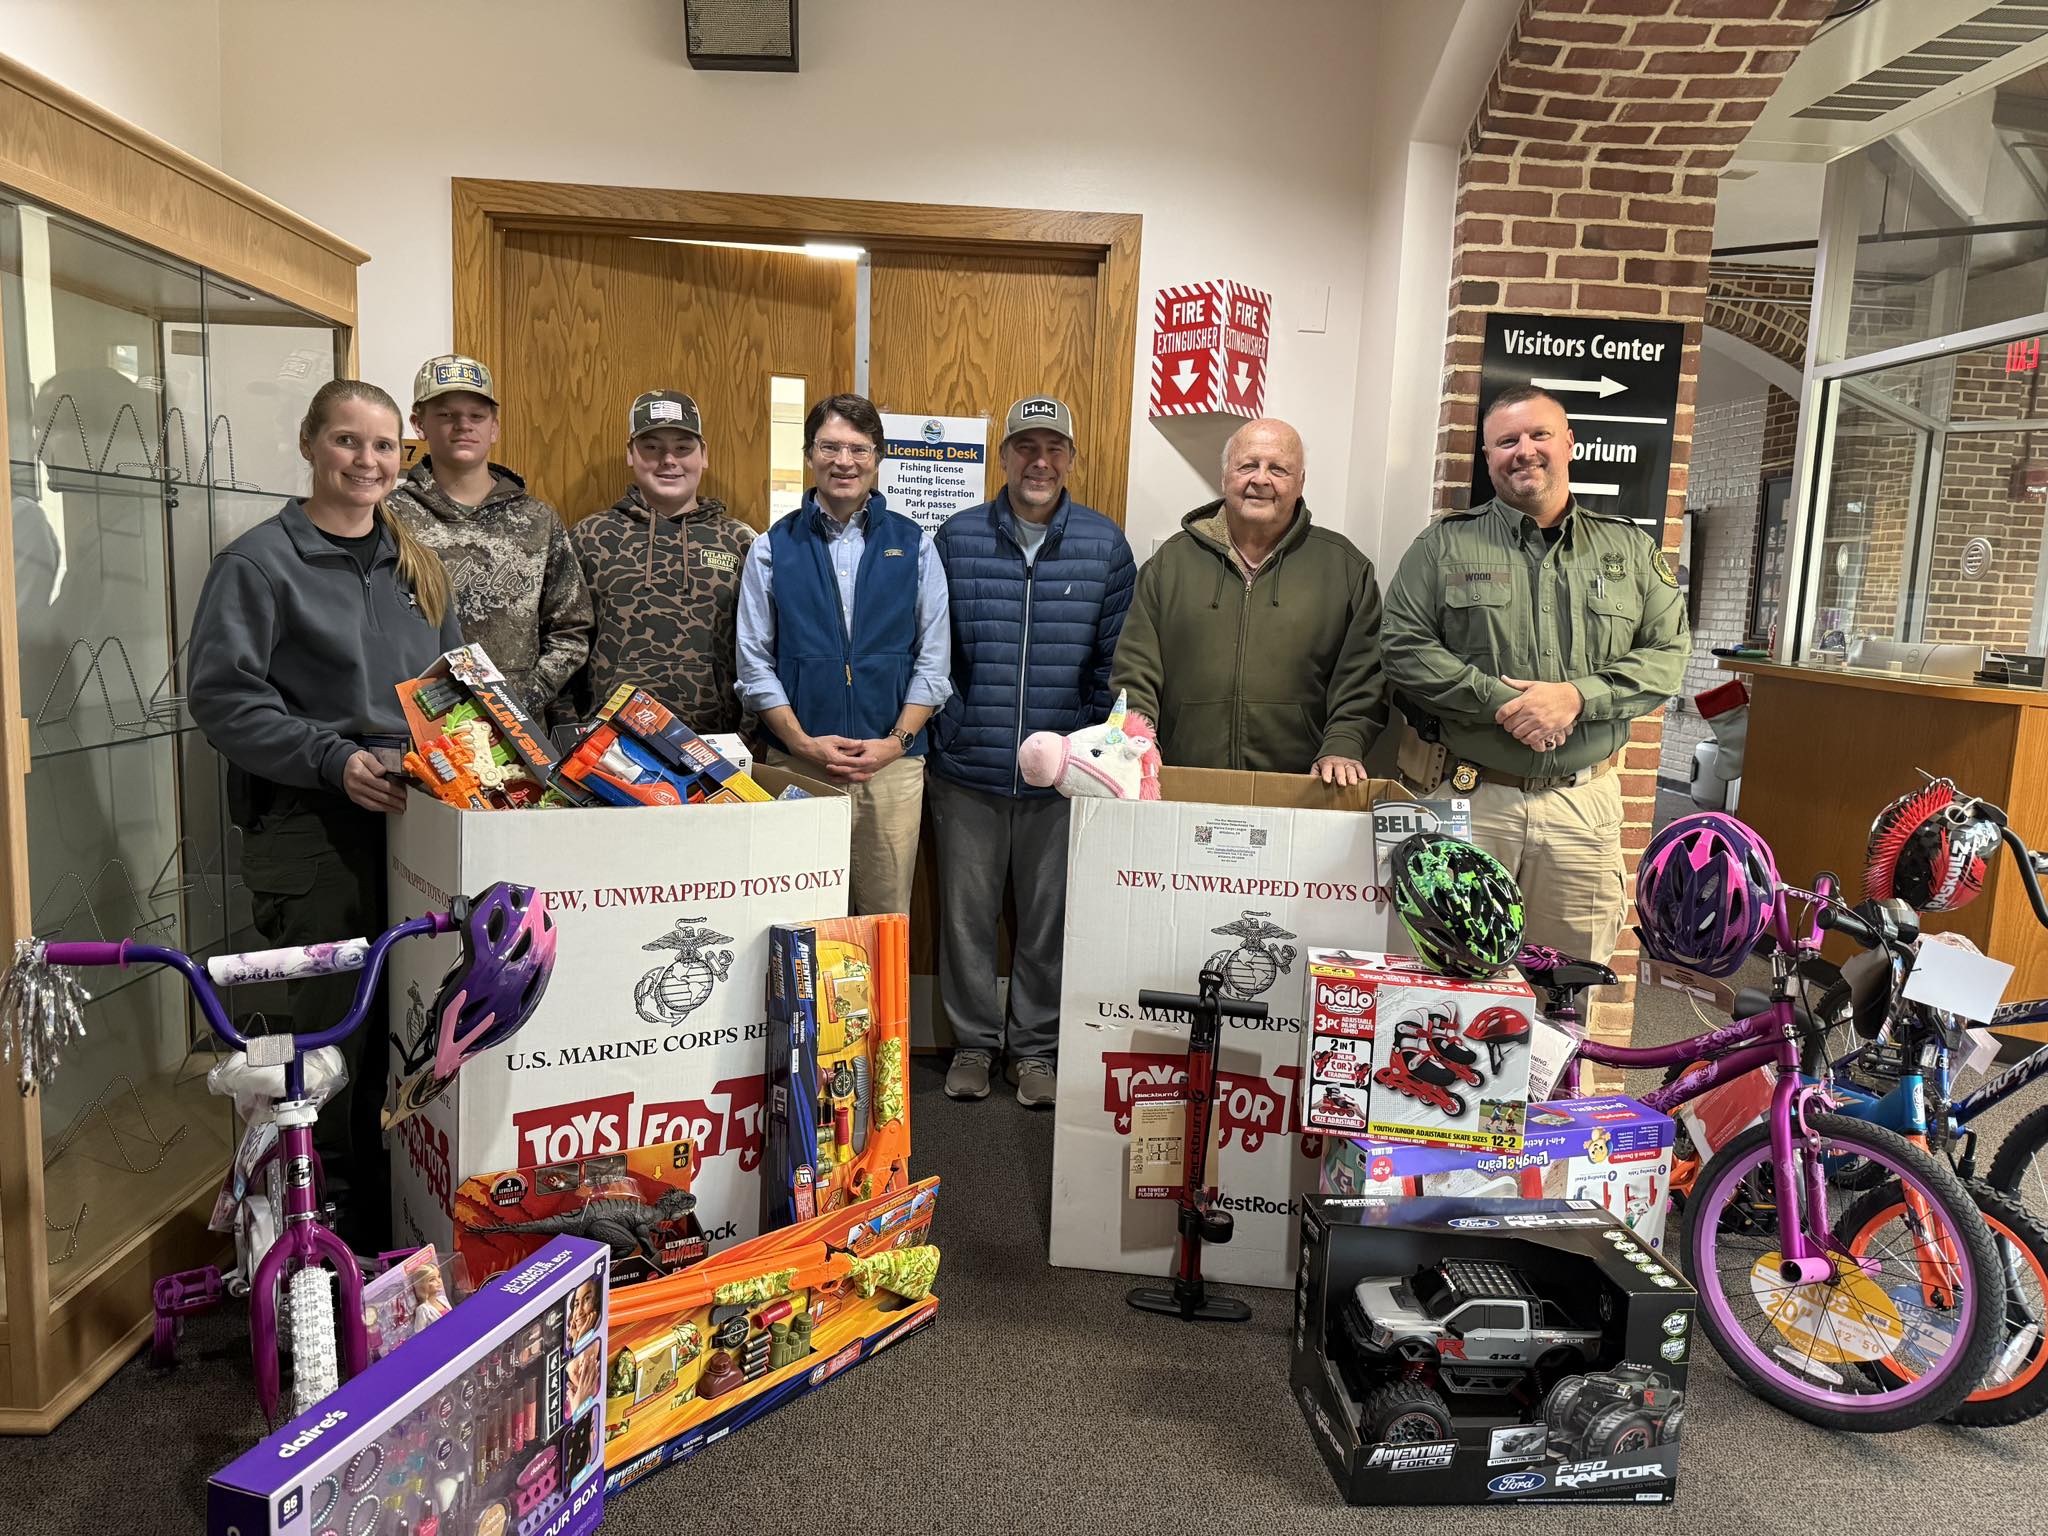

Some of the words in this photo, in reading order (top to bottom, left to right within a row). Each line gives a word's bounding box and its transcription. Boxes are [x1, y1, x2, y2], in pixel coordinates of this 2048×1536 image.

[1172, 299, 1206, 326] FIRE
[1235, 301, 1259, 328] FIRE
[1157, 326, 1219, 355] EXTINGUISHER
[1225, 325, 1267, 358] EXTINGUISHER
[1503, 329, 1585, 358] Visitors
[1591, 334, 1665, 362] Center
[440, 367, 461, 379] SURF
[463, 367, 479, 381] BGL
[405, 445, 417, 462] 7
[887, 444, 944, 460] Licensing
[947, 447, 978, 460] Desk
[1571, 437, 1637, 464] orium
[900, 462, 932, 474] Fishing
[933, 463, 964, 474] license
[897, 474, 933, 486] Hunting
[935, 476, 966, 486] license
[887, 485, 922, 497] Boating
[923, 487, 975, 498] registration
[905, 498, 926, 508] Park
[928, 501, 957, 509] passes
[911, 510, 930, 520] Surf
[931, 512, 950, 522] tags
[703, 550, 738, 564] ATLANTIC
[707, 556, 735, 569] SHOALS
[1464, 572, 1492, 583] WOOD
[682, 739, 720, 767] AGILITY
[1374, 815, 1429, 833] BELL
[1925, 840, 1972, 911] RASKULLZ
[593, 879, 737, 910] UNWRAPPED
[740, 875, 791, 899] TOYS
[793, 868, 846, 890] ONLY
[1116, 869, 1167, 894] NEW,
[1171, 872, 1300, 899] UNWRAPPED
[1303, 881, 1357, 903] TOYS
[1362, 884, 1393, 904] ON
[798, 940, 815, 1000] ADVENTURE
[1318, 983, 1375, 1010] halo
[1097, 1000, 1135, 1020] U.S.
[1229, 1014, 1301, 1034] CORPS
[1315, 1013, 1339, 1032] 3PC
[1341, 1016, 1373, 1026] ADJUSTABLE
[1340, 1027, 1359, 1035] COMBO
[506, 1050, 553, 1073] U.S.
[557, 1038, 658, 1068] MARINE
[662, 1026, 734, 1053] CORPS
[736, 1021, 773, 1044] RE
[1330, 1039, 1339, 1051] 2
[1340, 1042, 1348, 1051] IN
[1350, 1041, 1356, 1053] 1
[1336, 1061, 1347, 1070] OR
[1326, 1071, 1353, 1081] TRAINING
[1984, 1054, 2035, 1100] HUFFY
[1215, 1080, 1275, 1127] FOR
[1328, 1116, 1361, 1128] ADJUSTABLE
[524, 1111, 622, 1166] TOYS
[643, 1112, 713, 1153] FOR
[1372, 1124, 1414, 1137] YOUTH/JUNIOR
[1415, 1128, 1452, 1140] ADJUSTABLE
[1452, 1131, 1471, 1142] SKATE
[1471, 1134, 1488, 1144] SIZES
[1491, 1135, 1517, 1148] 12-2
[1523, 1138, 1544, 1147] Activ
[1545, 1136, 1566, 1146] 4-in-1
[1477, 1150, 1550, 1172] Laugh&Learn
[507, 1179, 512, 1188] 3
[1458, 1219, 1493, 1228] Ford
[1506, 1217, 1611, 1228] RAPTOR
[665, 1236, 701, 1250] ULTIMATE
[551, 1249, 573, 1263] BOX
[661, 1242, 705, 1265] DAMAGE
[500, 1260, 545, 1292] ULTIMATE
[508, 1261, 555, 1294] GLAMOUR
[1437, 1338, 1468, 1361] R
[1489, 1353, 1521, 1361] 4x4
[278, 1409, 349, 1459] claire's
[1367, 1443, 1455, 1467] ADVENTURE
[1394, 1456, 1447, 1471] FORCE
[603, 1445, 665, 1493] ADVENTURE
[1554, 1463, 1667, 1489] RAPTOR
[1555, 1460, 1608, 1476] F-150
[1498, 1475, 1535, 1492] Ford
[283, 1494, 298, 1515] 86
[573, 1479, 600, 1515] BOX
